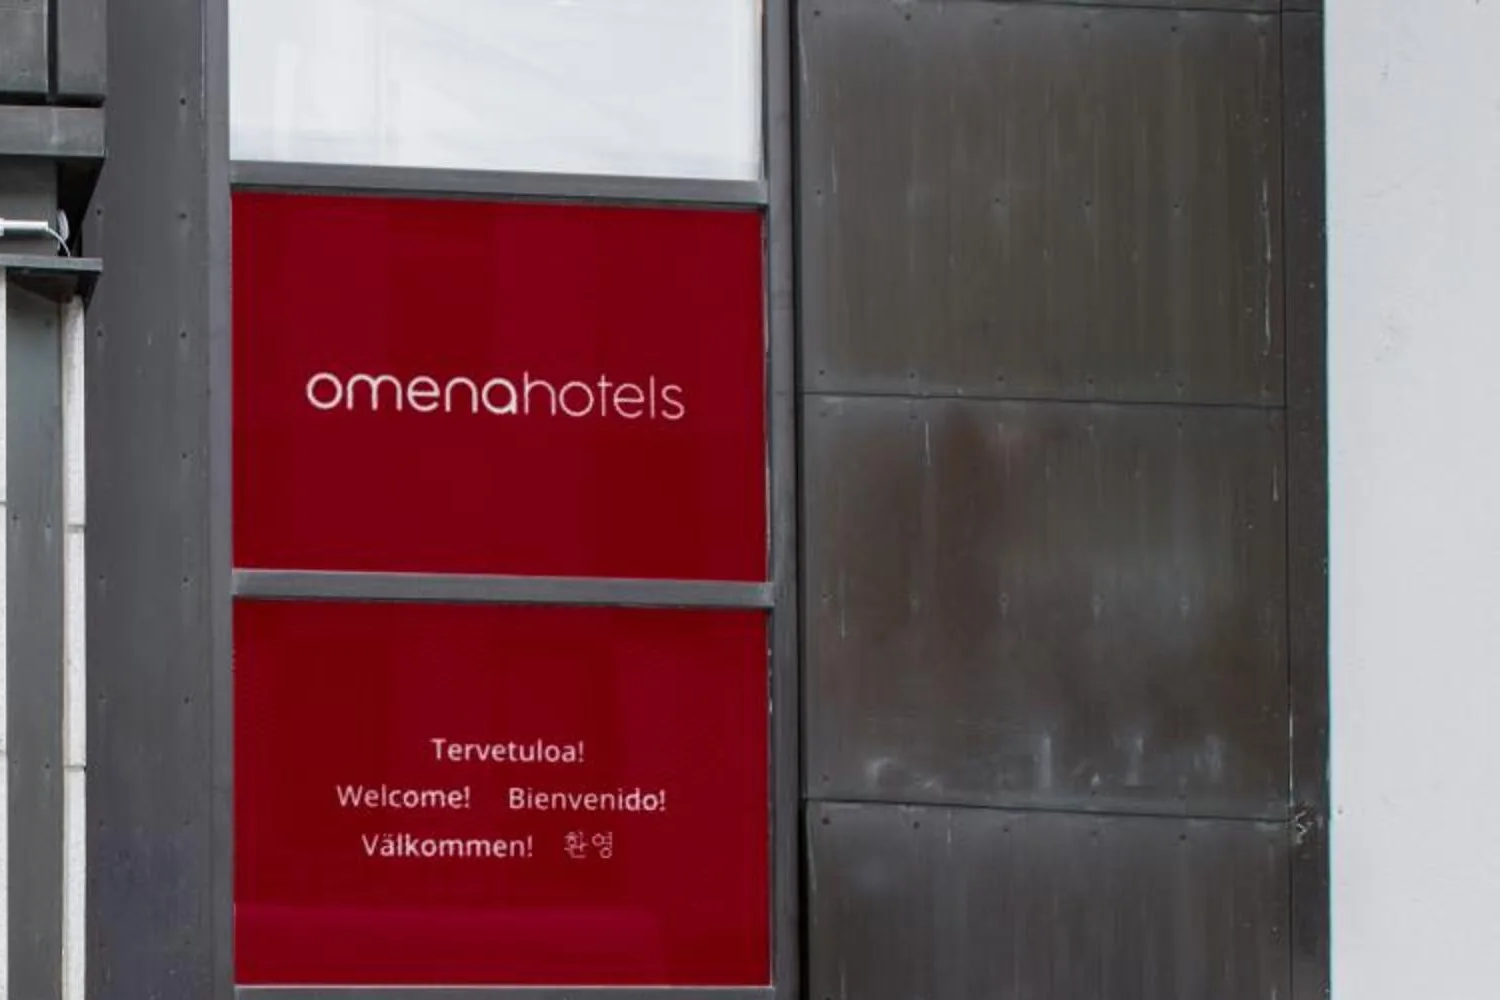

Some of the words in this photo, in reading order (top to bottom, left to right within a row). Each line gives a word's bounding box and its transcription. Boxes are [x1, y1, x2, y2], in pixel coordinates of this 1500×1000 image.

[305, 370, 686, 420] omenahotels
[431, 738, 585, 763] Tervetuloa!
[336, 784, 471, 809] Welcome!
[509, 787, 666, 811] Bienvenido!
[361, 832, 534, 858] Välkommen!
